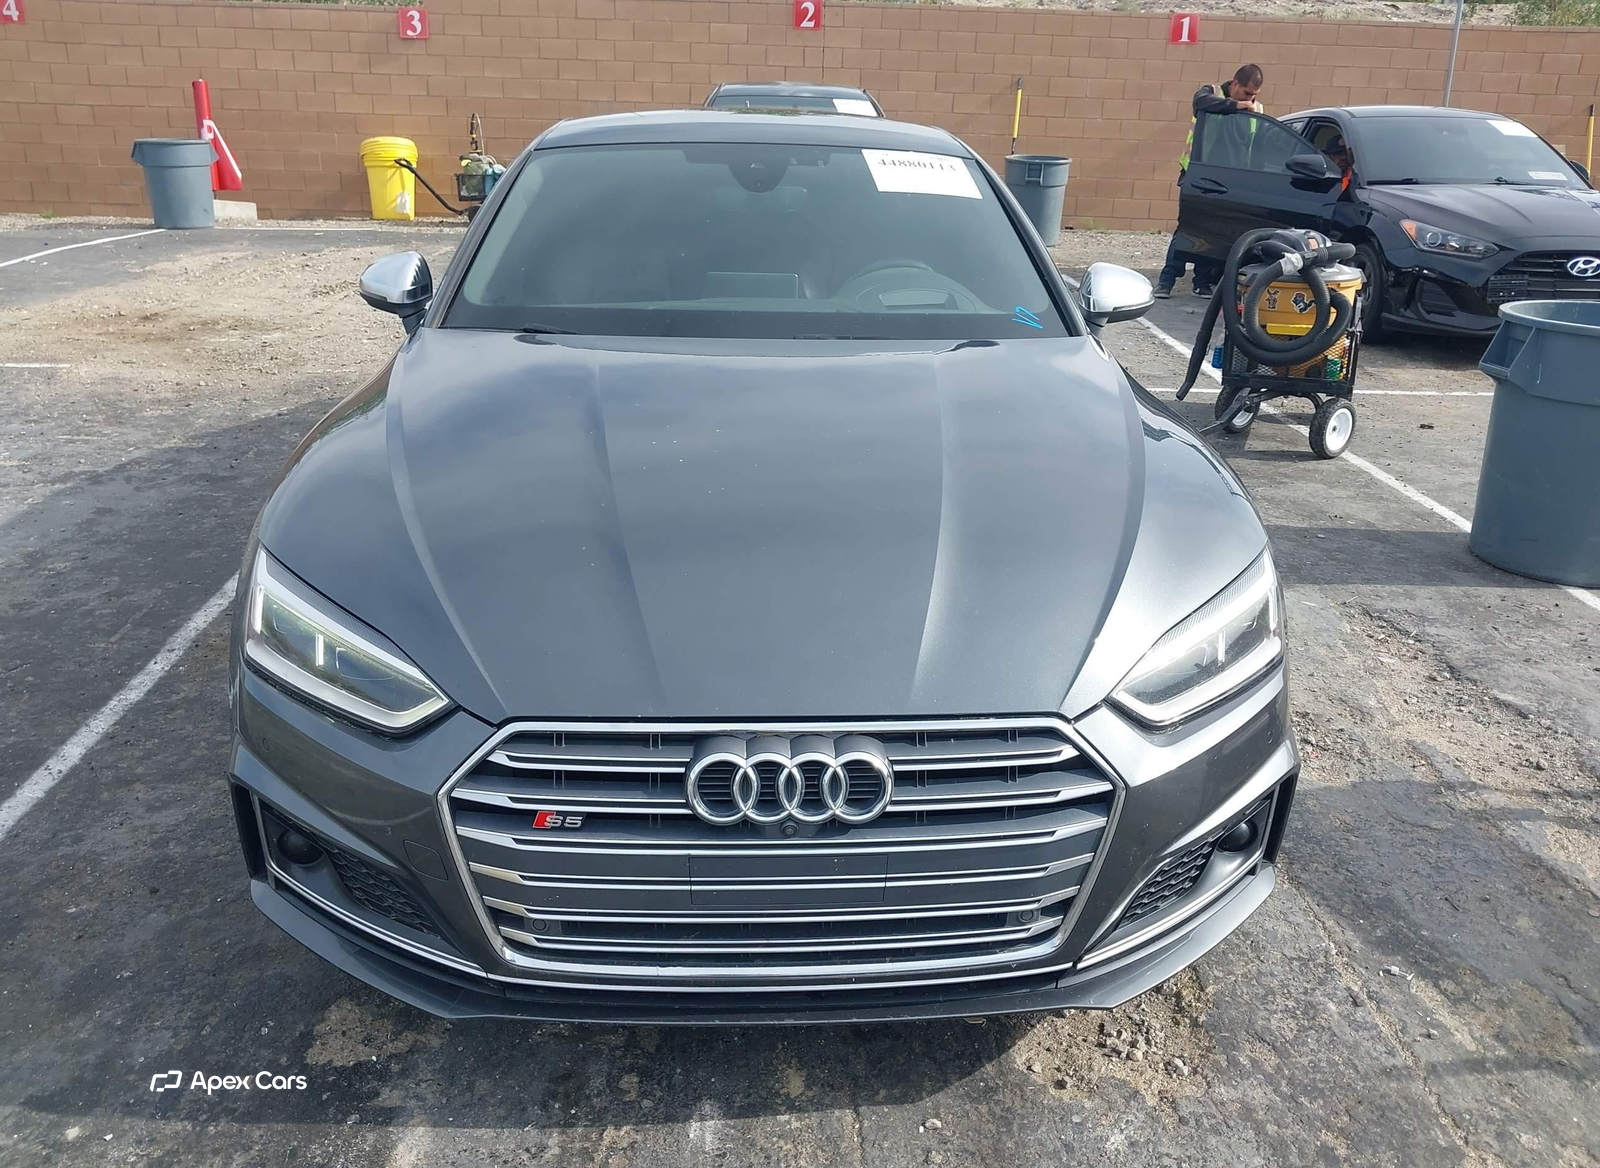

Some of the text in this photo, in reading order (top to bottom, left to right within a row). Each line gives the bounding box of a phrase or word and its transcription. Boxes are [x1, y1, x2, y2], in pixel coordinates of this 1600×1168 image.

[3, 0, 19, 20] 4
[407, 10, 421, 36] 3
[800, 1, 815, 27] 2
[1179, 16, 1191, 42] 1
[544, 815, 583, 828] S5
